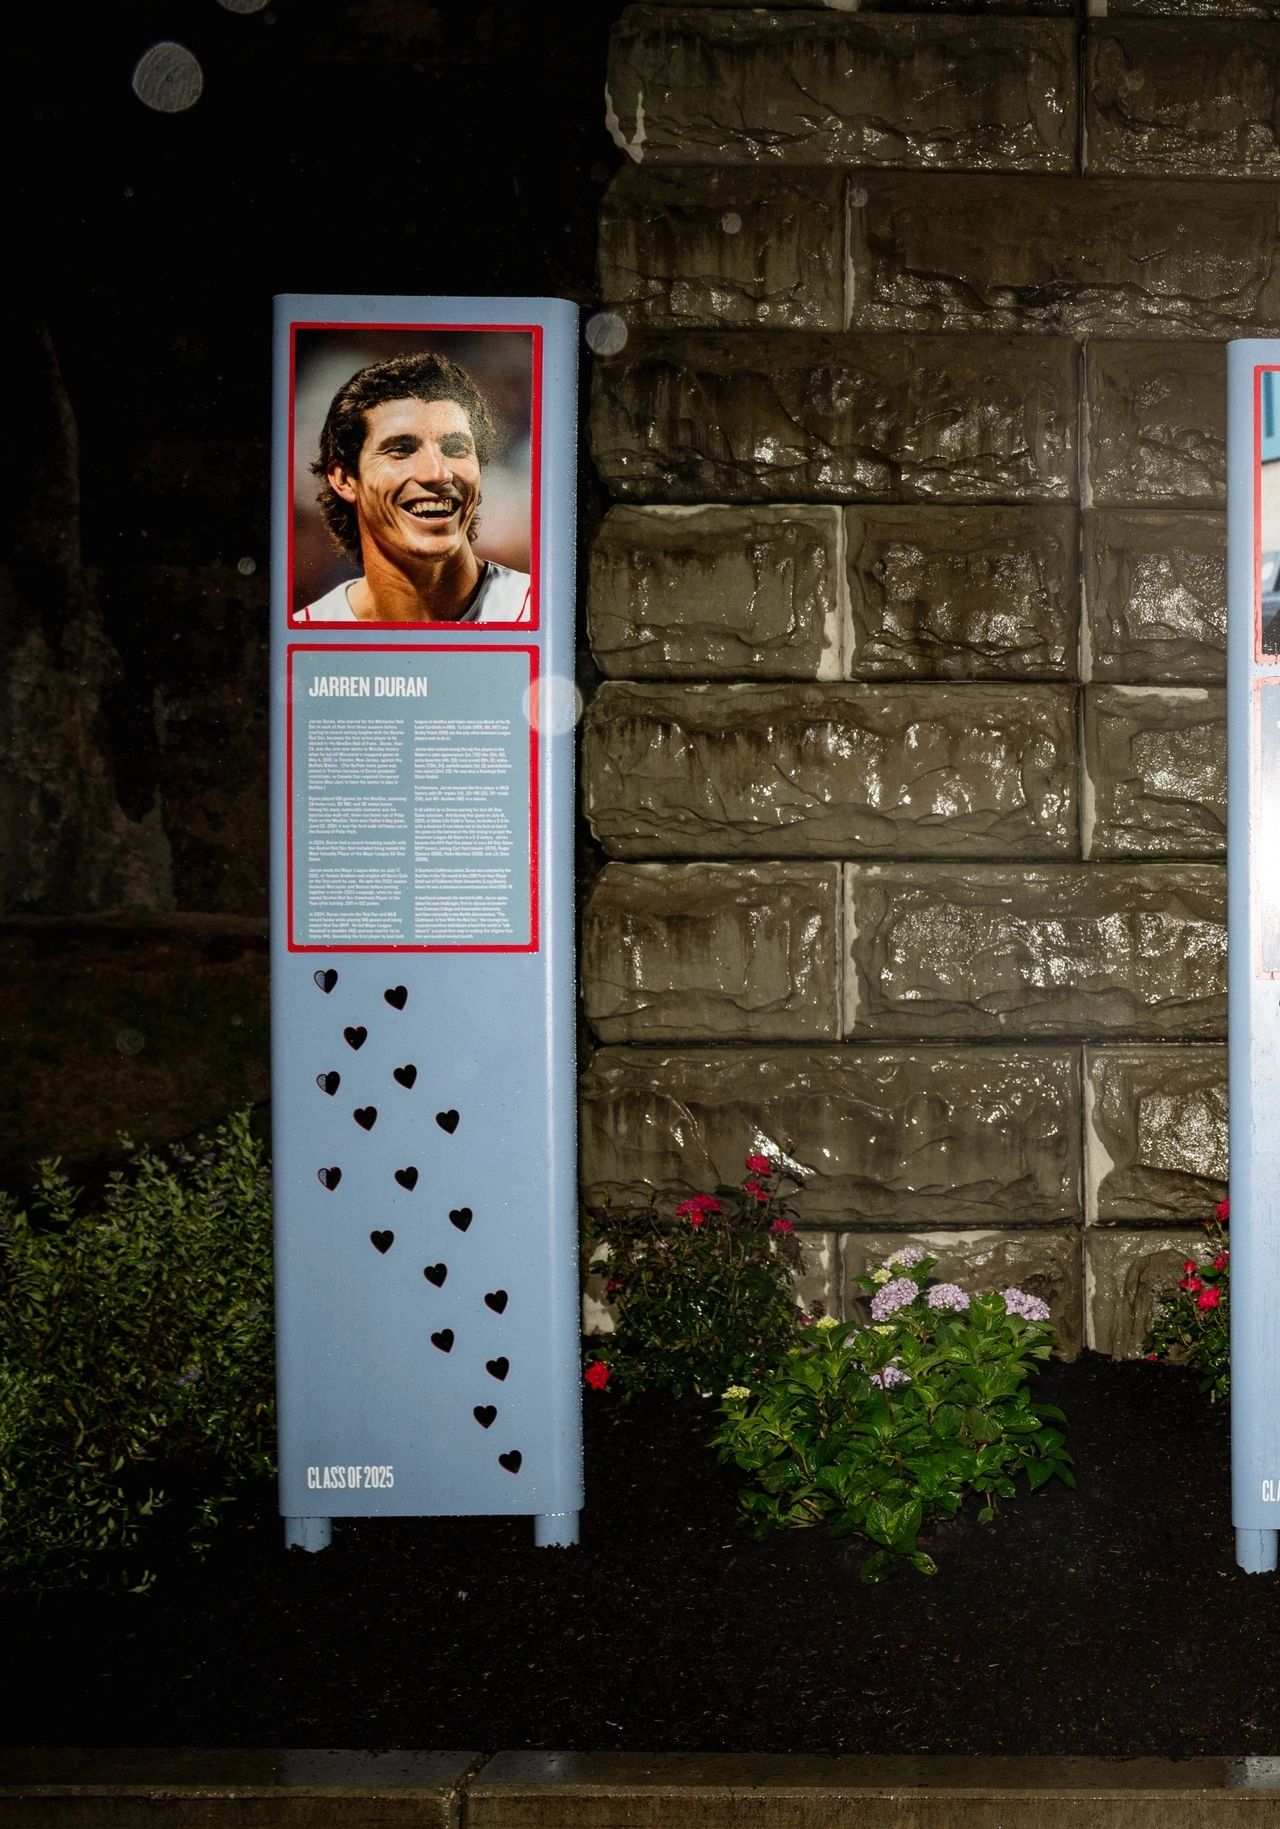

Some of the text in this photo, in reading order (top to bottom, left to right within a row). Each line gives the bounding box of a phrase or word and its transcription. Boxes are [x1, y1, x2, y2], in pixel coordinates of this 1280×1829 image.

[308, 676, 428, 698] JARREN DURAN
[307, 1466, 395, 1489] CLASS OF 2025
